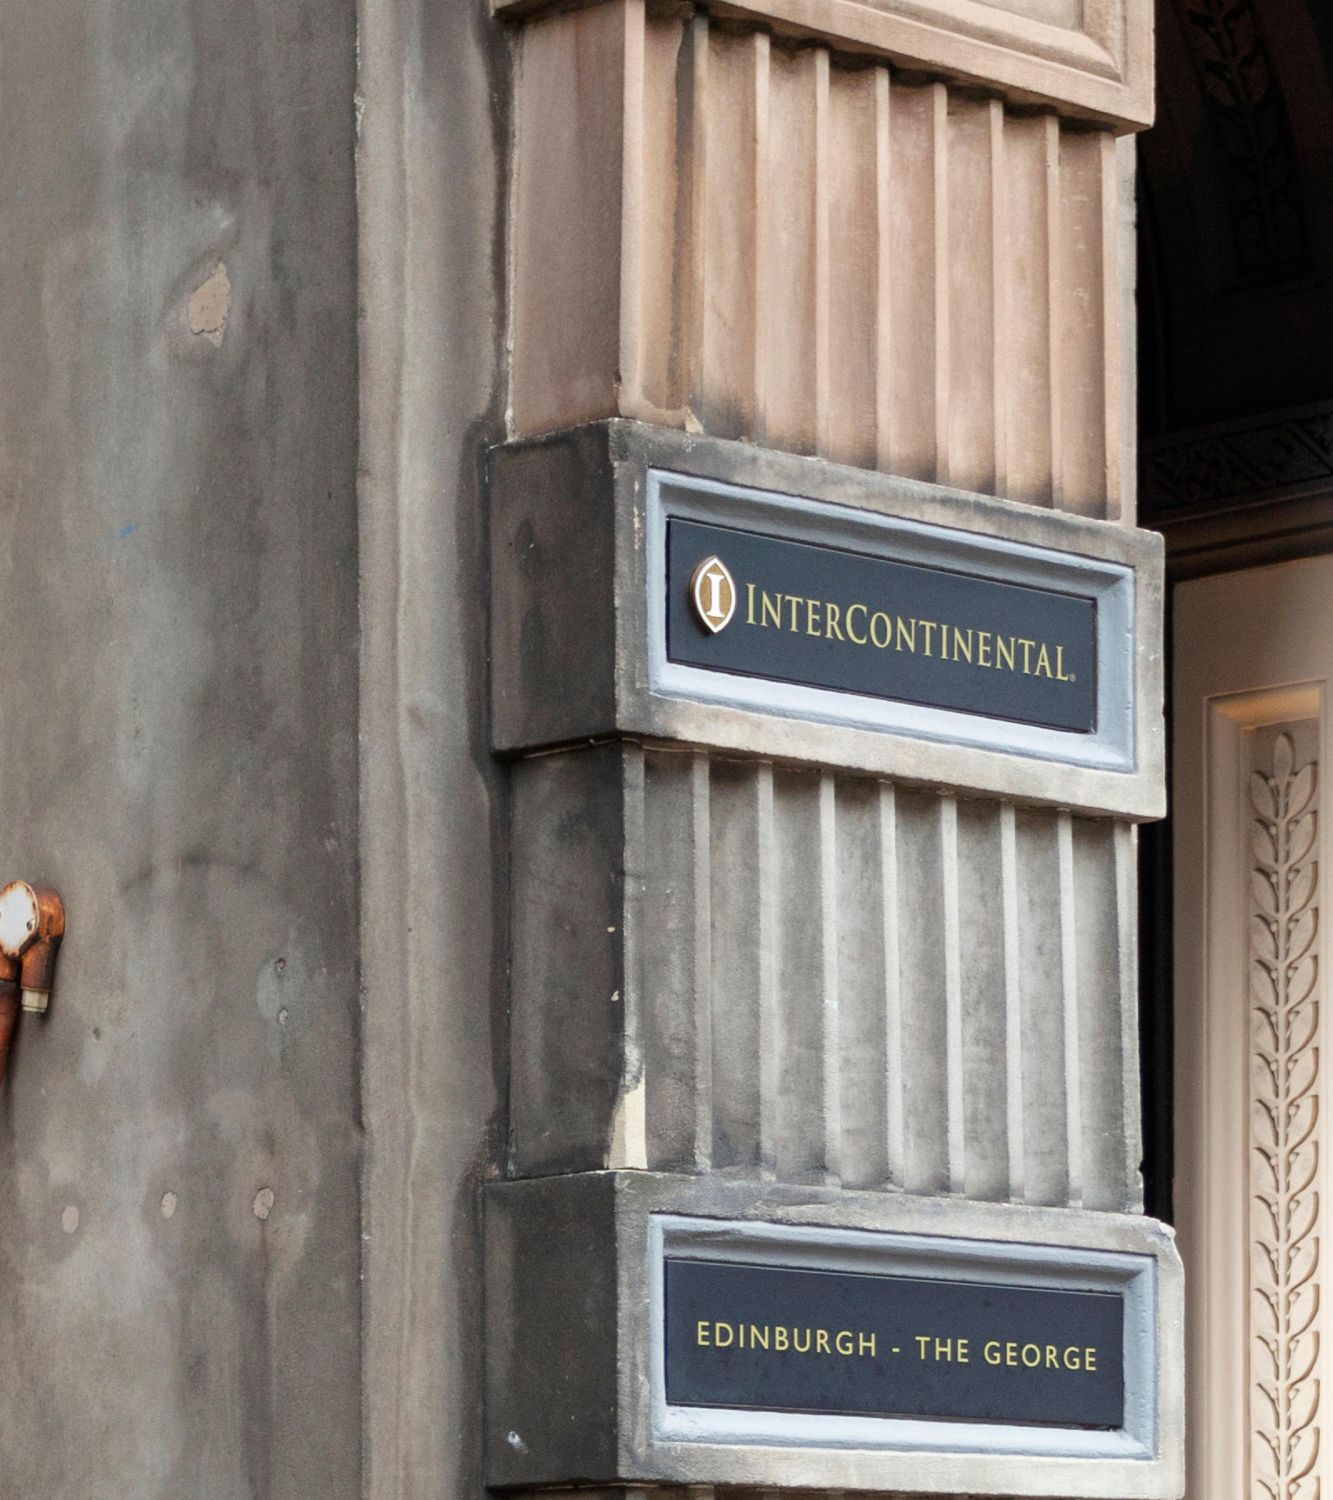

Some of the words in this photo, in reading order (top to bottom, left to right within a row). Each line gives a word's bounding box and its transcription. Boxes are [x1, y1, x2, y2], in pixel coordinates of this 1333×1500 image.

[697, 1321, 876, 1357] EDINBURGH
[915, 1336, 969, 1363] THE
[984, 1341, 1097, 1371] GEORGE
